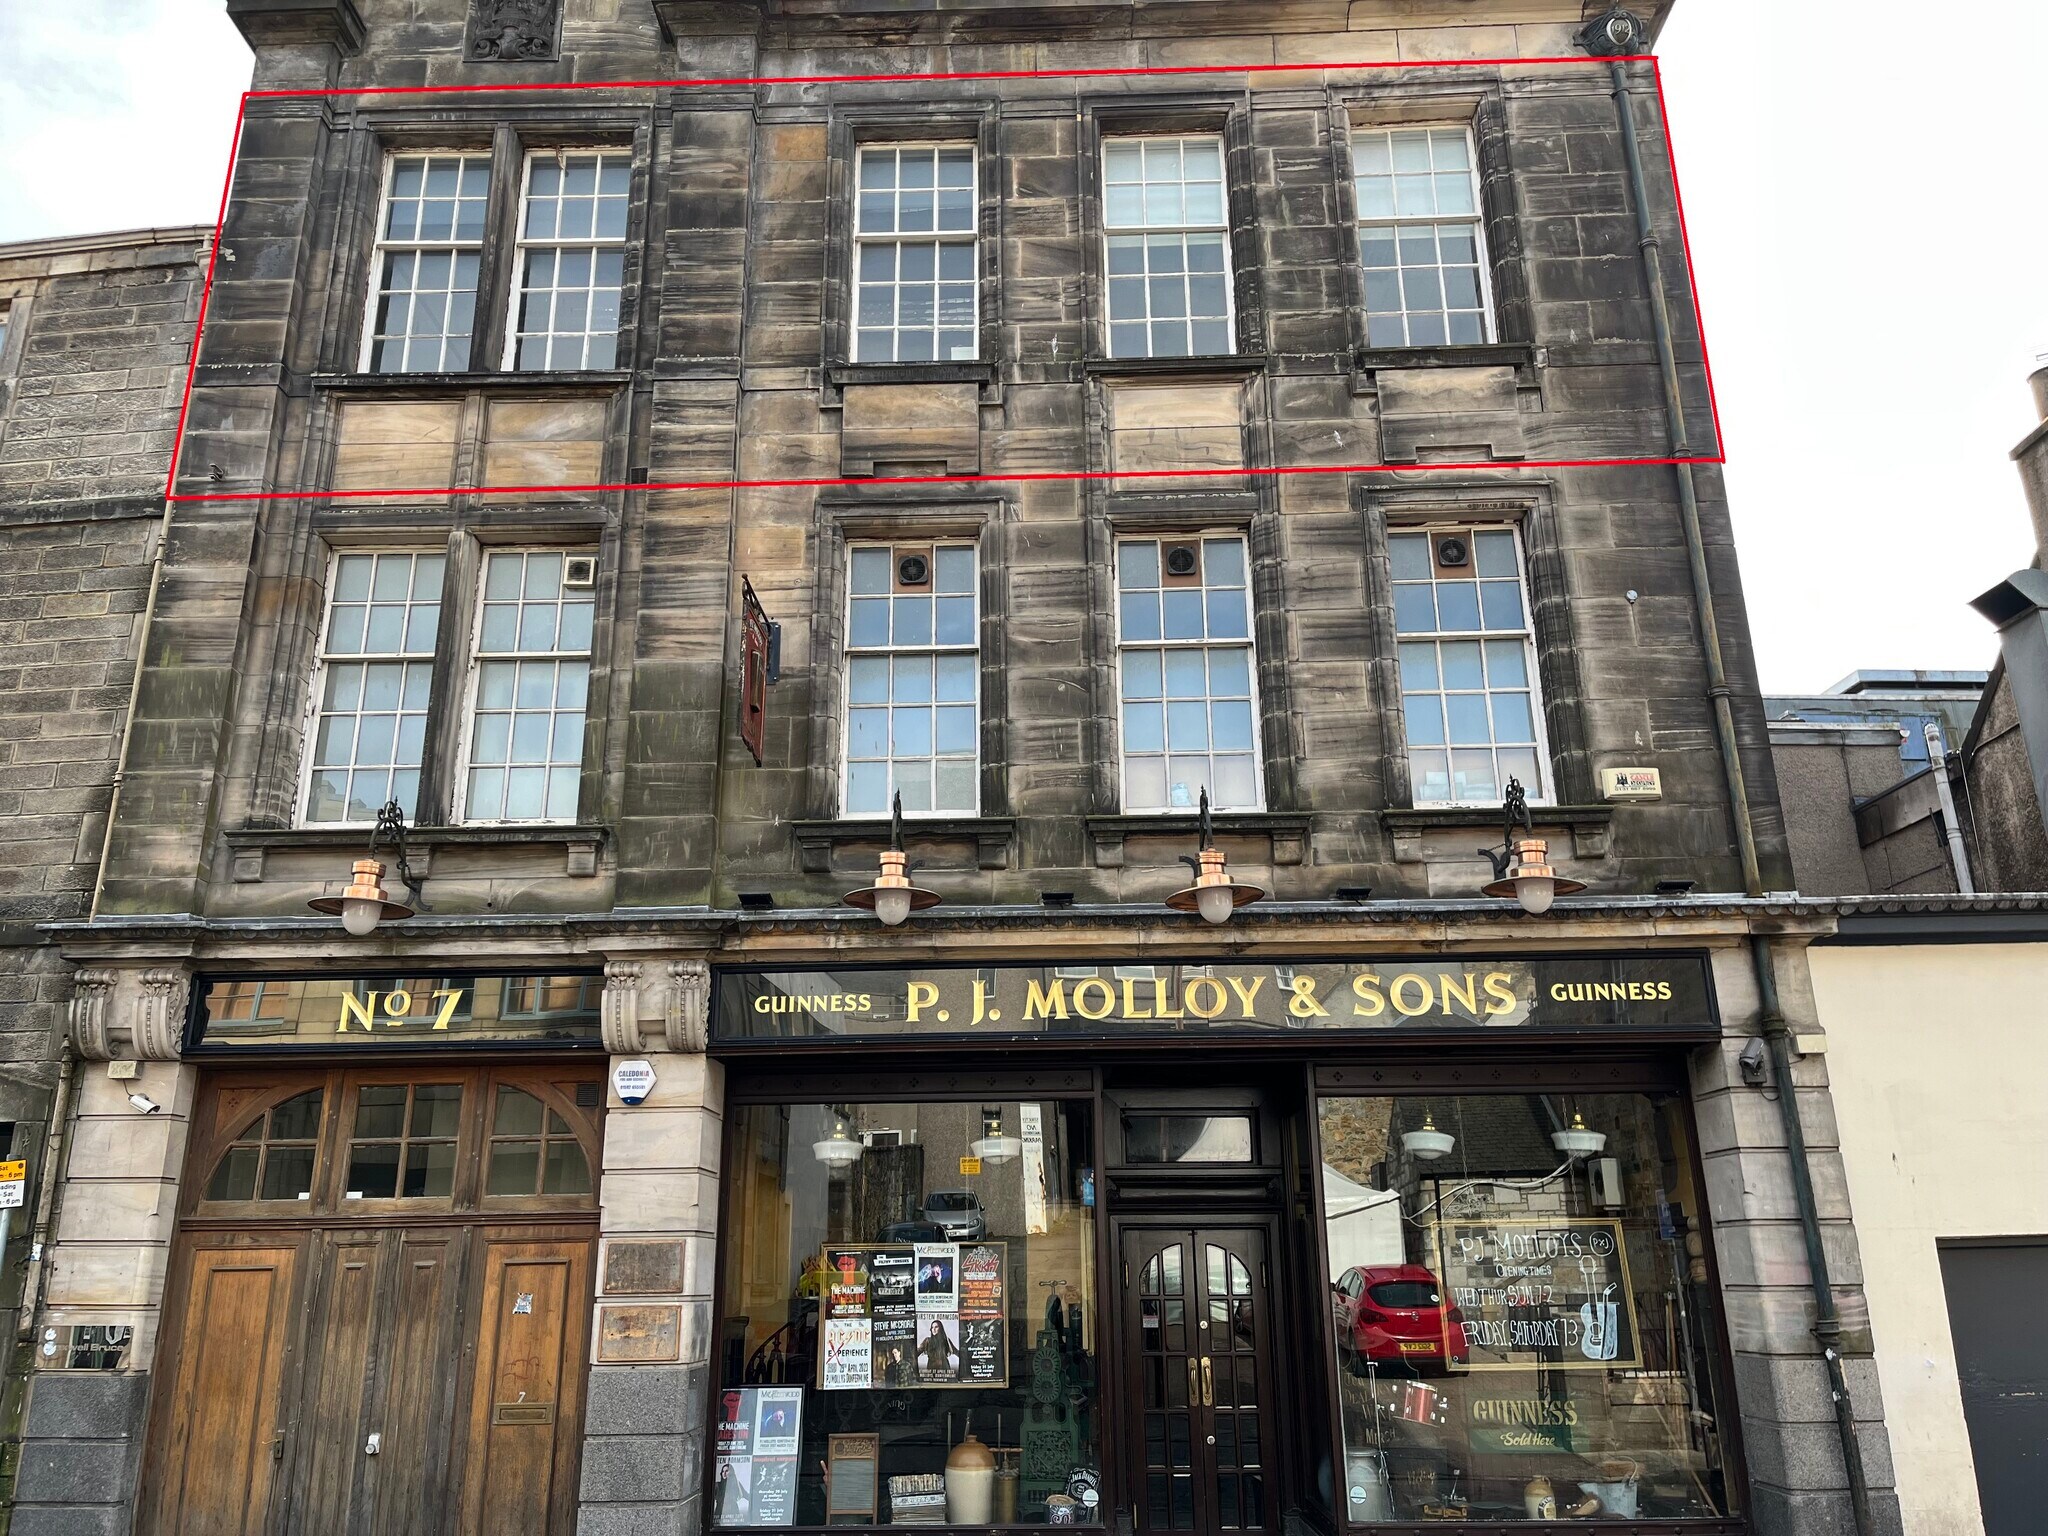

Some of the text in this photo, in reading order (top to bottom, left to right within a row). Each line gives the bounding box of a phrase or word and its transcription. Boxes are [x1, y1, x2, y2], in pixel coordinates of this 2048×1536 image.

[905, 972, 1517, 1025] P. J. MOLLOY & SONS
[1550, 982, 1672, 1002] GUINNESS
[431, 989, 463, 1030] 7
[754, 994, 871, 1013] GUINNESS
[1460, 1232, 1582, 1263] PJ MOLLOYS
[1495, 1264, 1552, 1277] OPENING TIMES
[842, 1285, 865, 1294] MACHINE
[874, 1321, 889, 1330] STEVIE
[90, 1343, 123, 1352] Bruce
[518, 1391, 526, 1403] 7
[1473, 1400, 1578, 1426] GUINNESS
[726, 1422, 749, 1430] MACHINE
[1500, 1431, 1555, 1446] Sold Here
[1071, 1473, 1082, 1483] JACK
